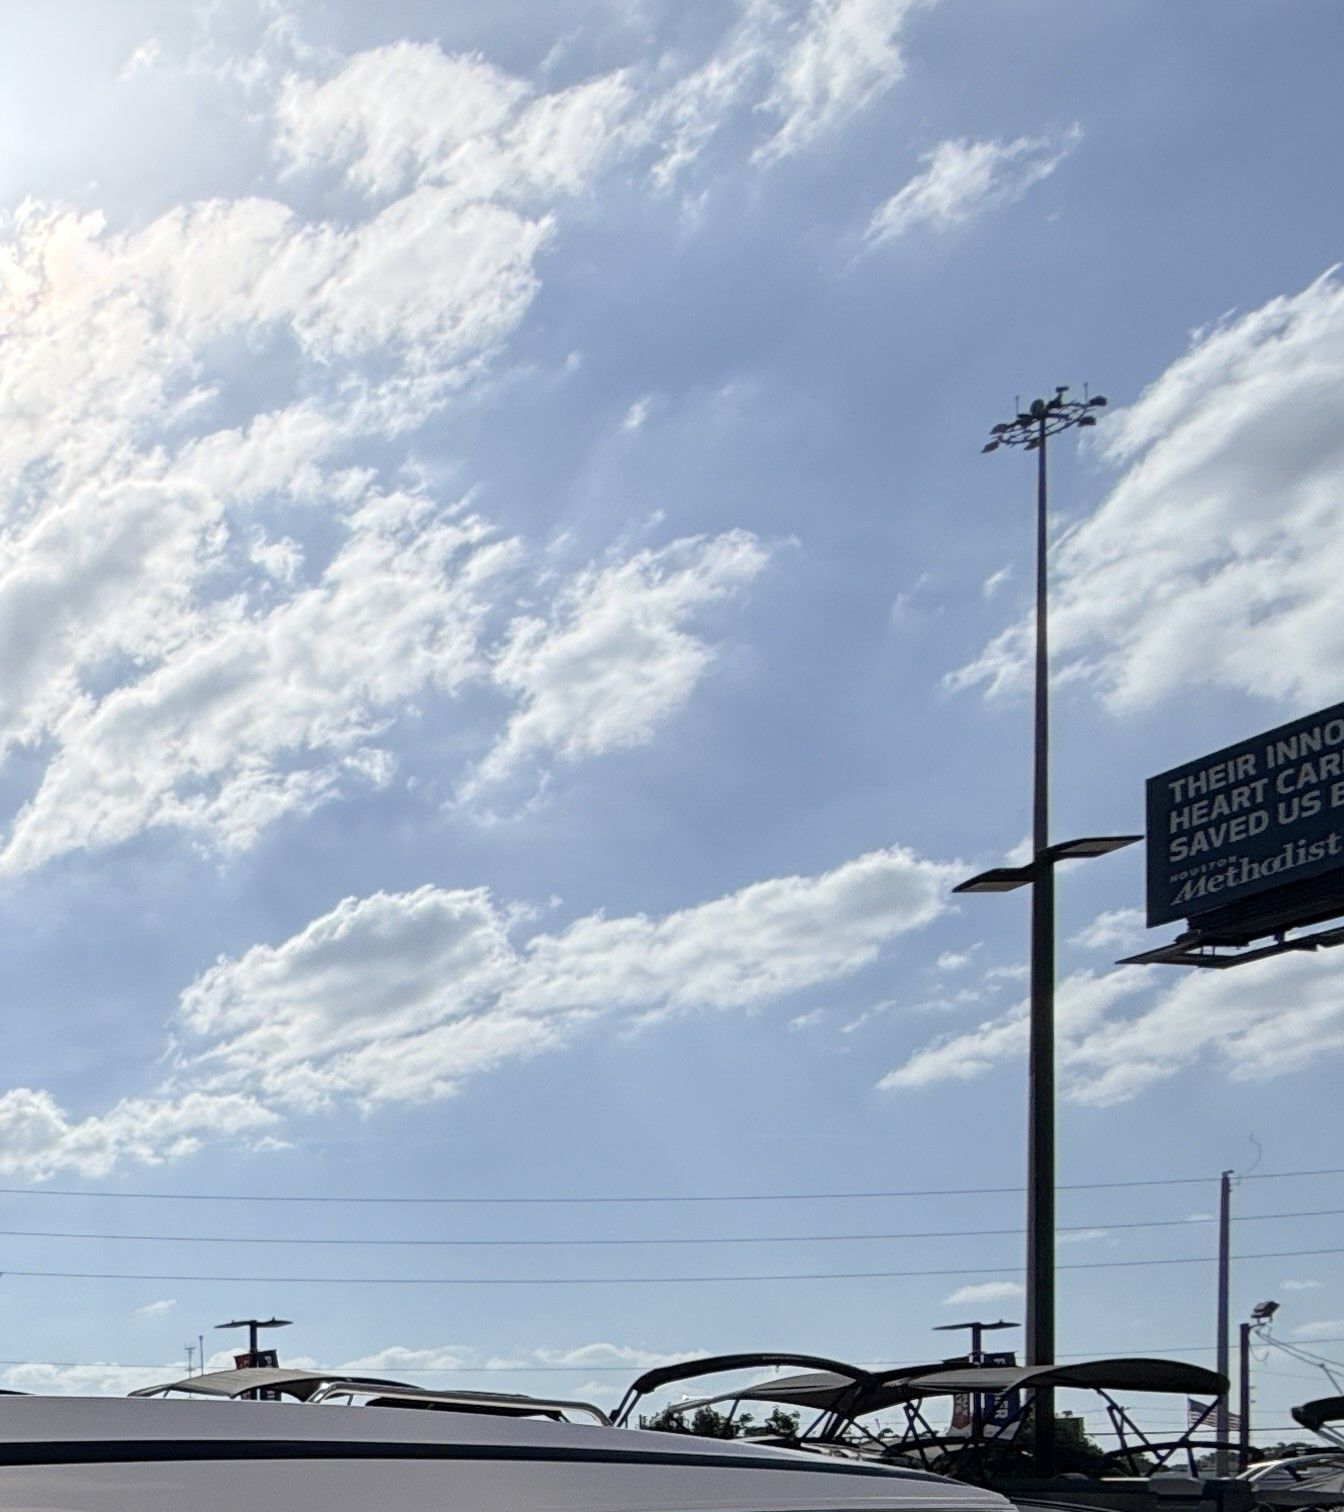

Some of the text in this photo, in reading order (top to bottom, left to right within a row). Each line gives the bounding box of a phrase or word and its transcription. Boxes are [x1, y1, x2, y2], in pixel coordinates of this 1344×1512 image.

[1169, 753, 1256, 803] THEIR
[1169, 751, 1344, 834] HEART CAR
[1169, 809, 1269, 862] SAVED
[1278, 790, 1321, 825] US
[1169, 832, 1343, 905] Methodist
